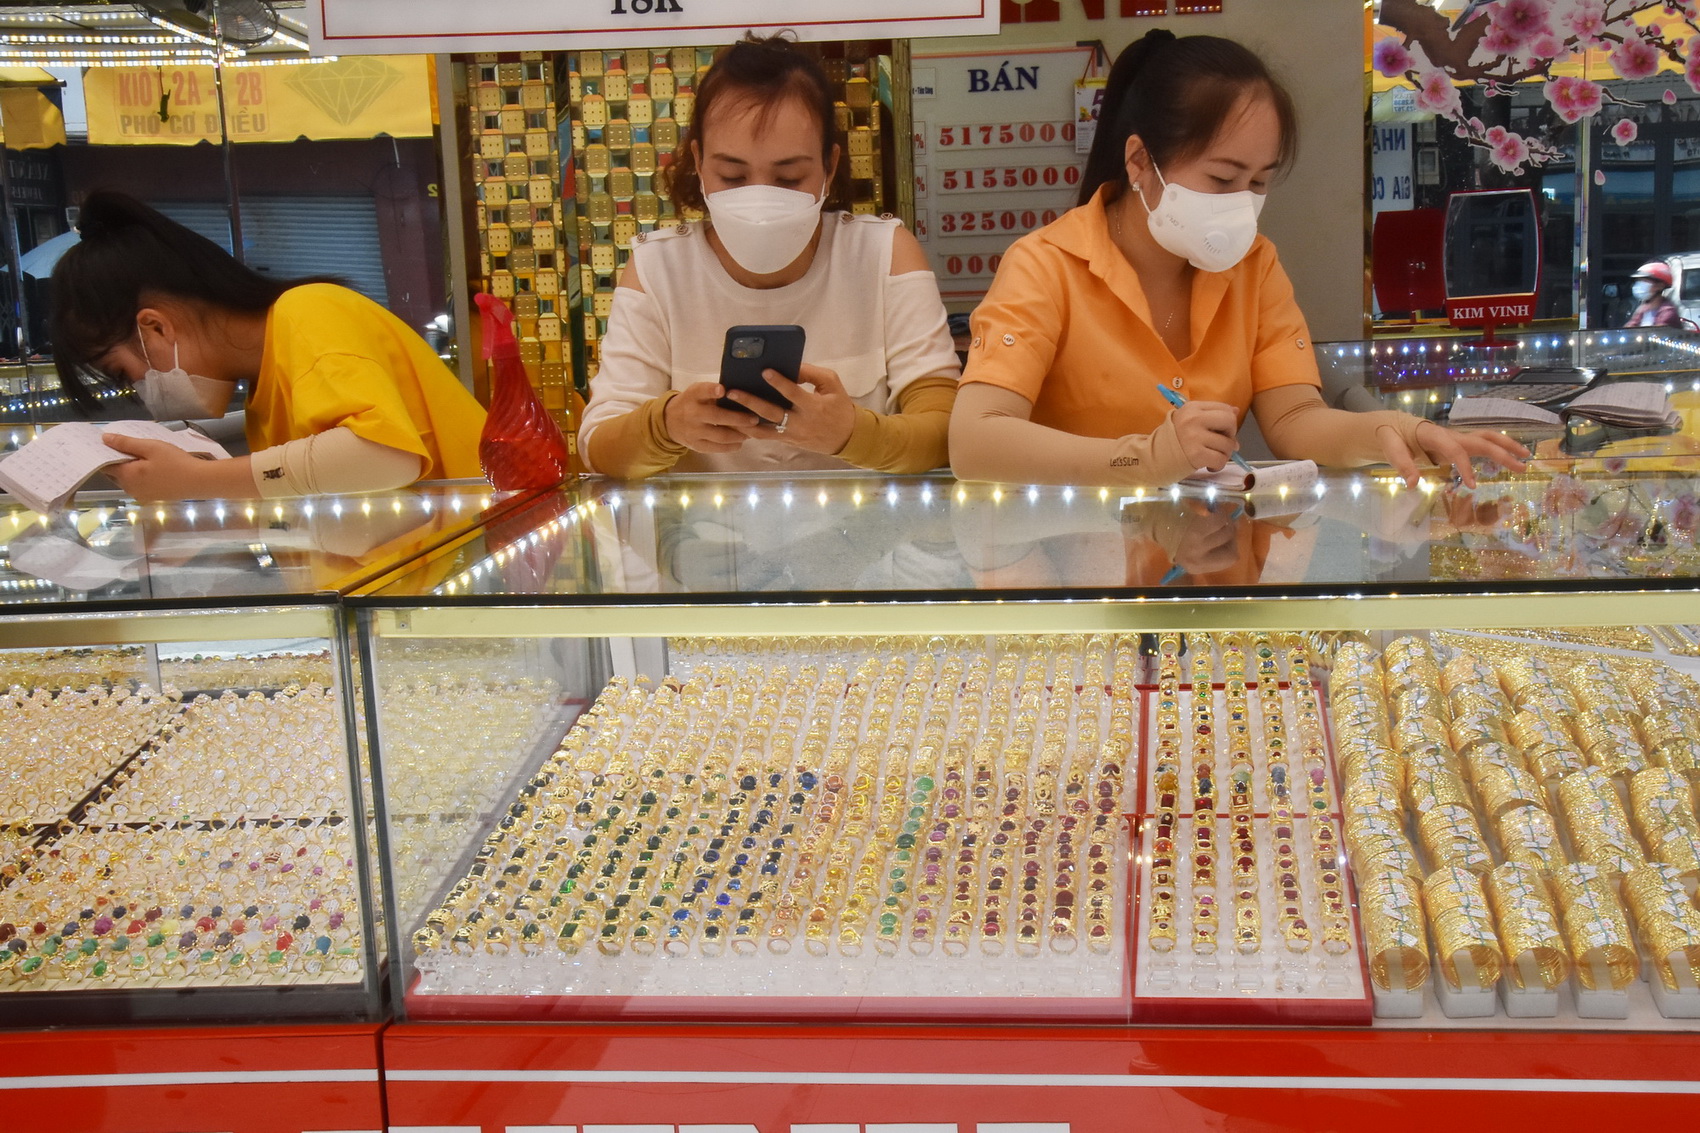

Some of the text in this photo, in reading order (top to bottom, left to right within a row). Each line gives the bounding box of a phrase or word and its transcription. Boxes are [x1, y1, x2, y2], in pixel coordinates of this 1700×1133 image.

[172, 70, 200, 106] 2A
[236, 71, 263, 106] 2B
[968, 60, 1040, 93] BÁN
[939, 122, 1076, 146] 5175000
[943, 166, 1080, 190] 5155000
[941, 209, 1073, 233] 325000
[1453, 304, 1530, 319] KIM VINH
